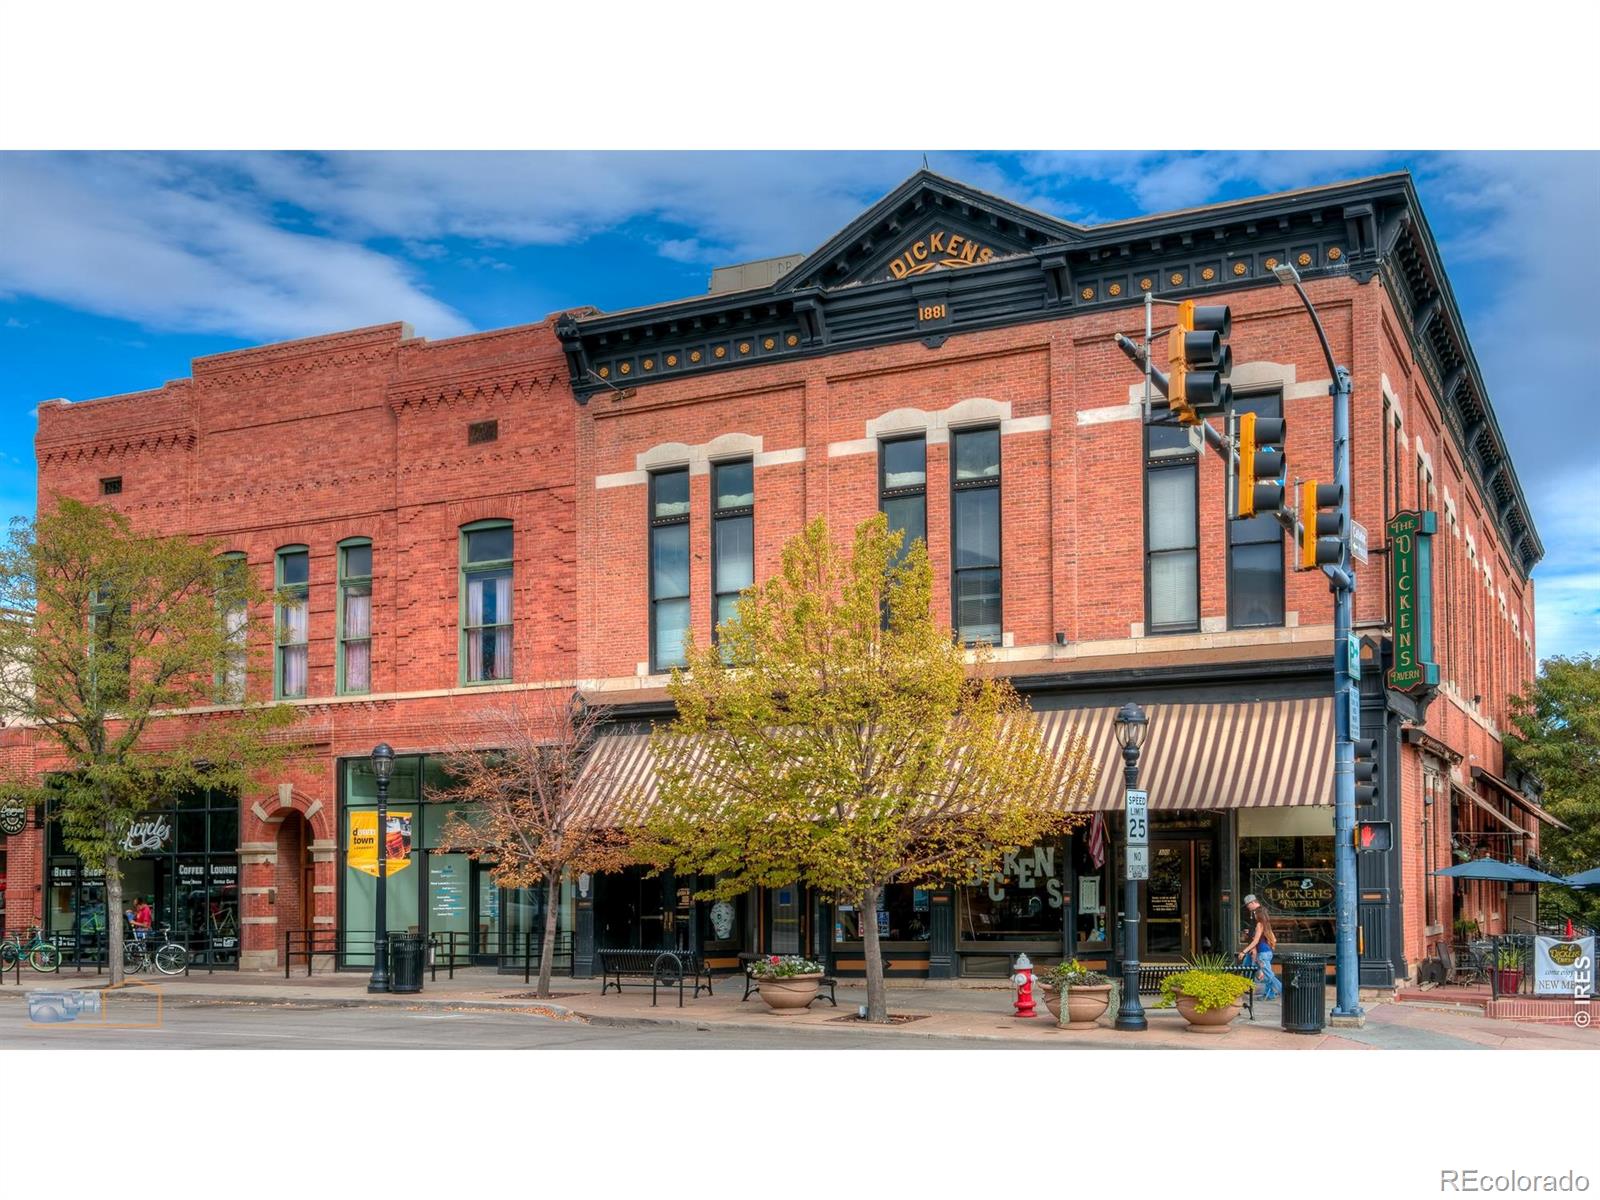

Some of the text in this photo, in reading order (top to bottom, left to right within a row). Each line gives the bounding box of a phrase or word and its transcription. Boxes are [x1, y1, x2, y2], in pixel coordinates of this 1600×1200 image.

[889, 231, 993, 280] DICKENS
[919, 304, 945, 320] 1881
[1391, 520, 1414, 533] THE
[1395, 534, 1411, 666] DICKENS
[1391, 670, 1420, 682] TAVERN
[1128, 795, 1146, 806] SPEED
[1130, 807, 1144, 816] LIMIT
[1129, 819, 1146, 838] 25
[353, 836, 374, 844] town
[1133, 852, 1141, 861] NO
[54, 867, 72, 877] BIKE
[179, 864, 204, 875] COFFEE
[210, 864, 237, 875] LOUNGE
[1264, 888, 1332, 901] DICKENS
[1279, 900, 1320, 909] TAVERN
[1539, 980, 1559, 990] NEW
